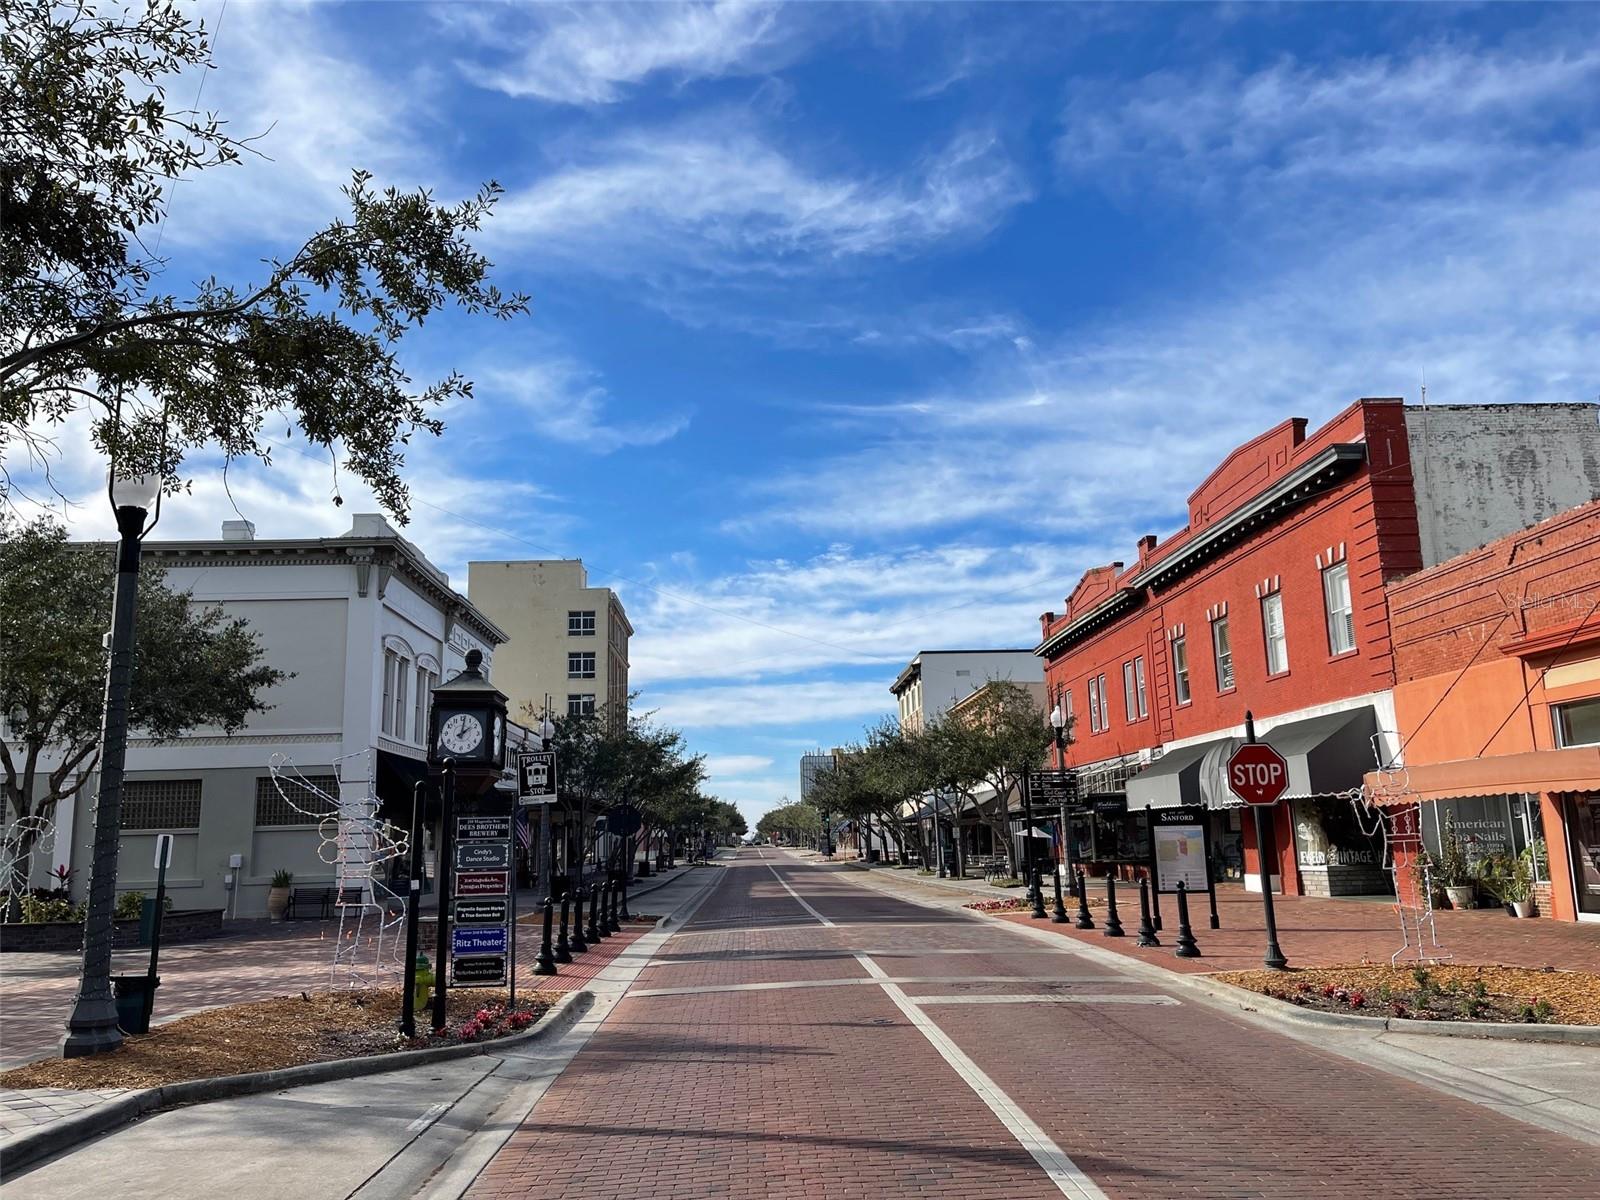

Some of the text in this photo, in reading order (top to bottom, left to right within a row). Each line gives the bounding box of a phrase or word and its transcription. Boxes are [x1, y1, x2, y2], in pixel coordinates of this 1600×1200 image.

[521, 755, 552, 768] TROLLEY
[1234, 764, 1281, 785] STOP
[530, 787, 545, 795] STOP
[1161, 813, 1194, 821] SANFORD
[1474, 832, 1506, 841] Nails
[456, 939, 471, 947] Ritz
